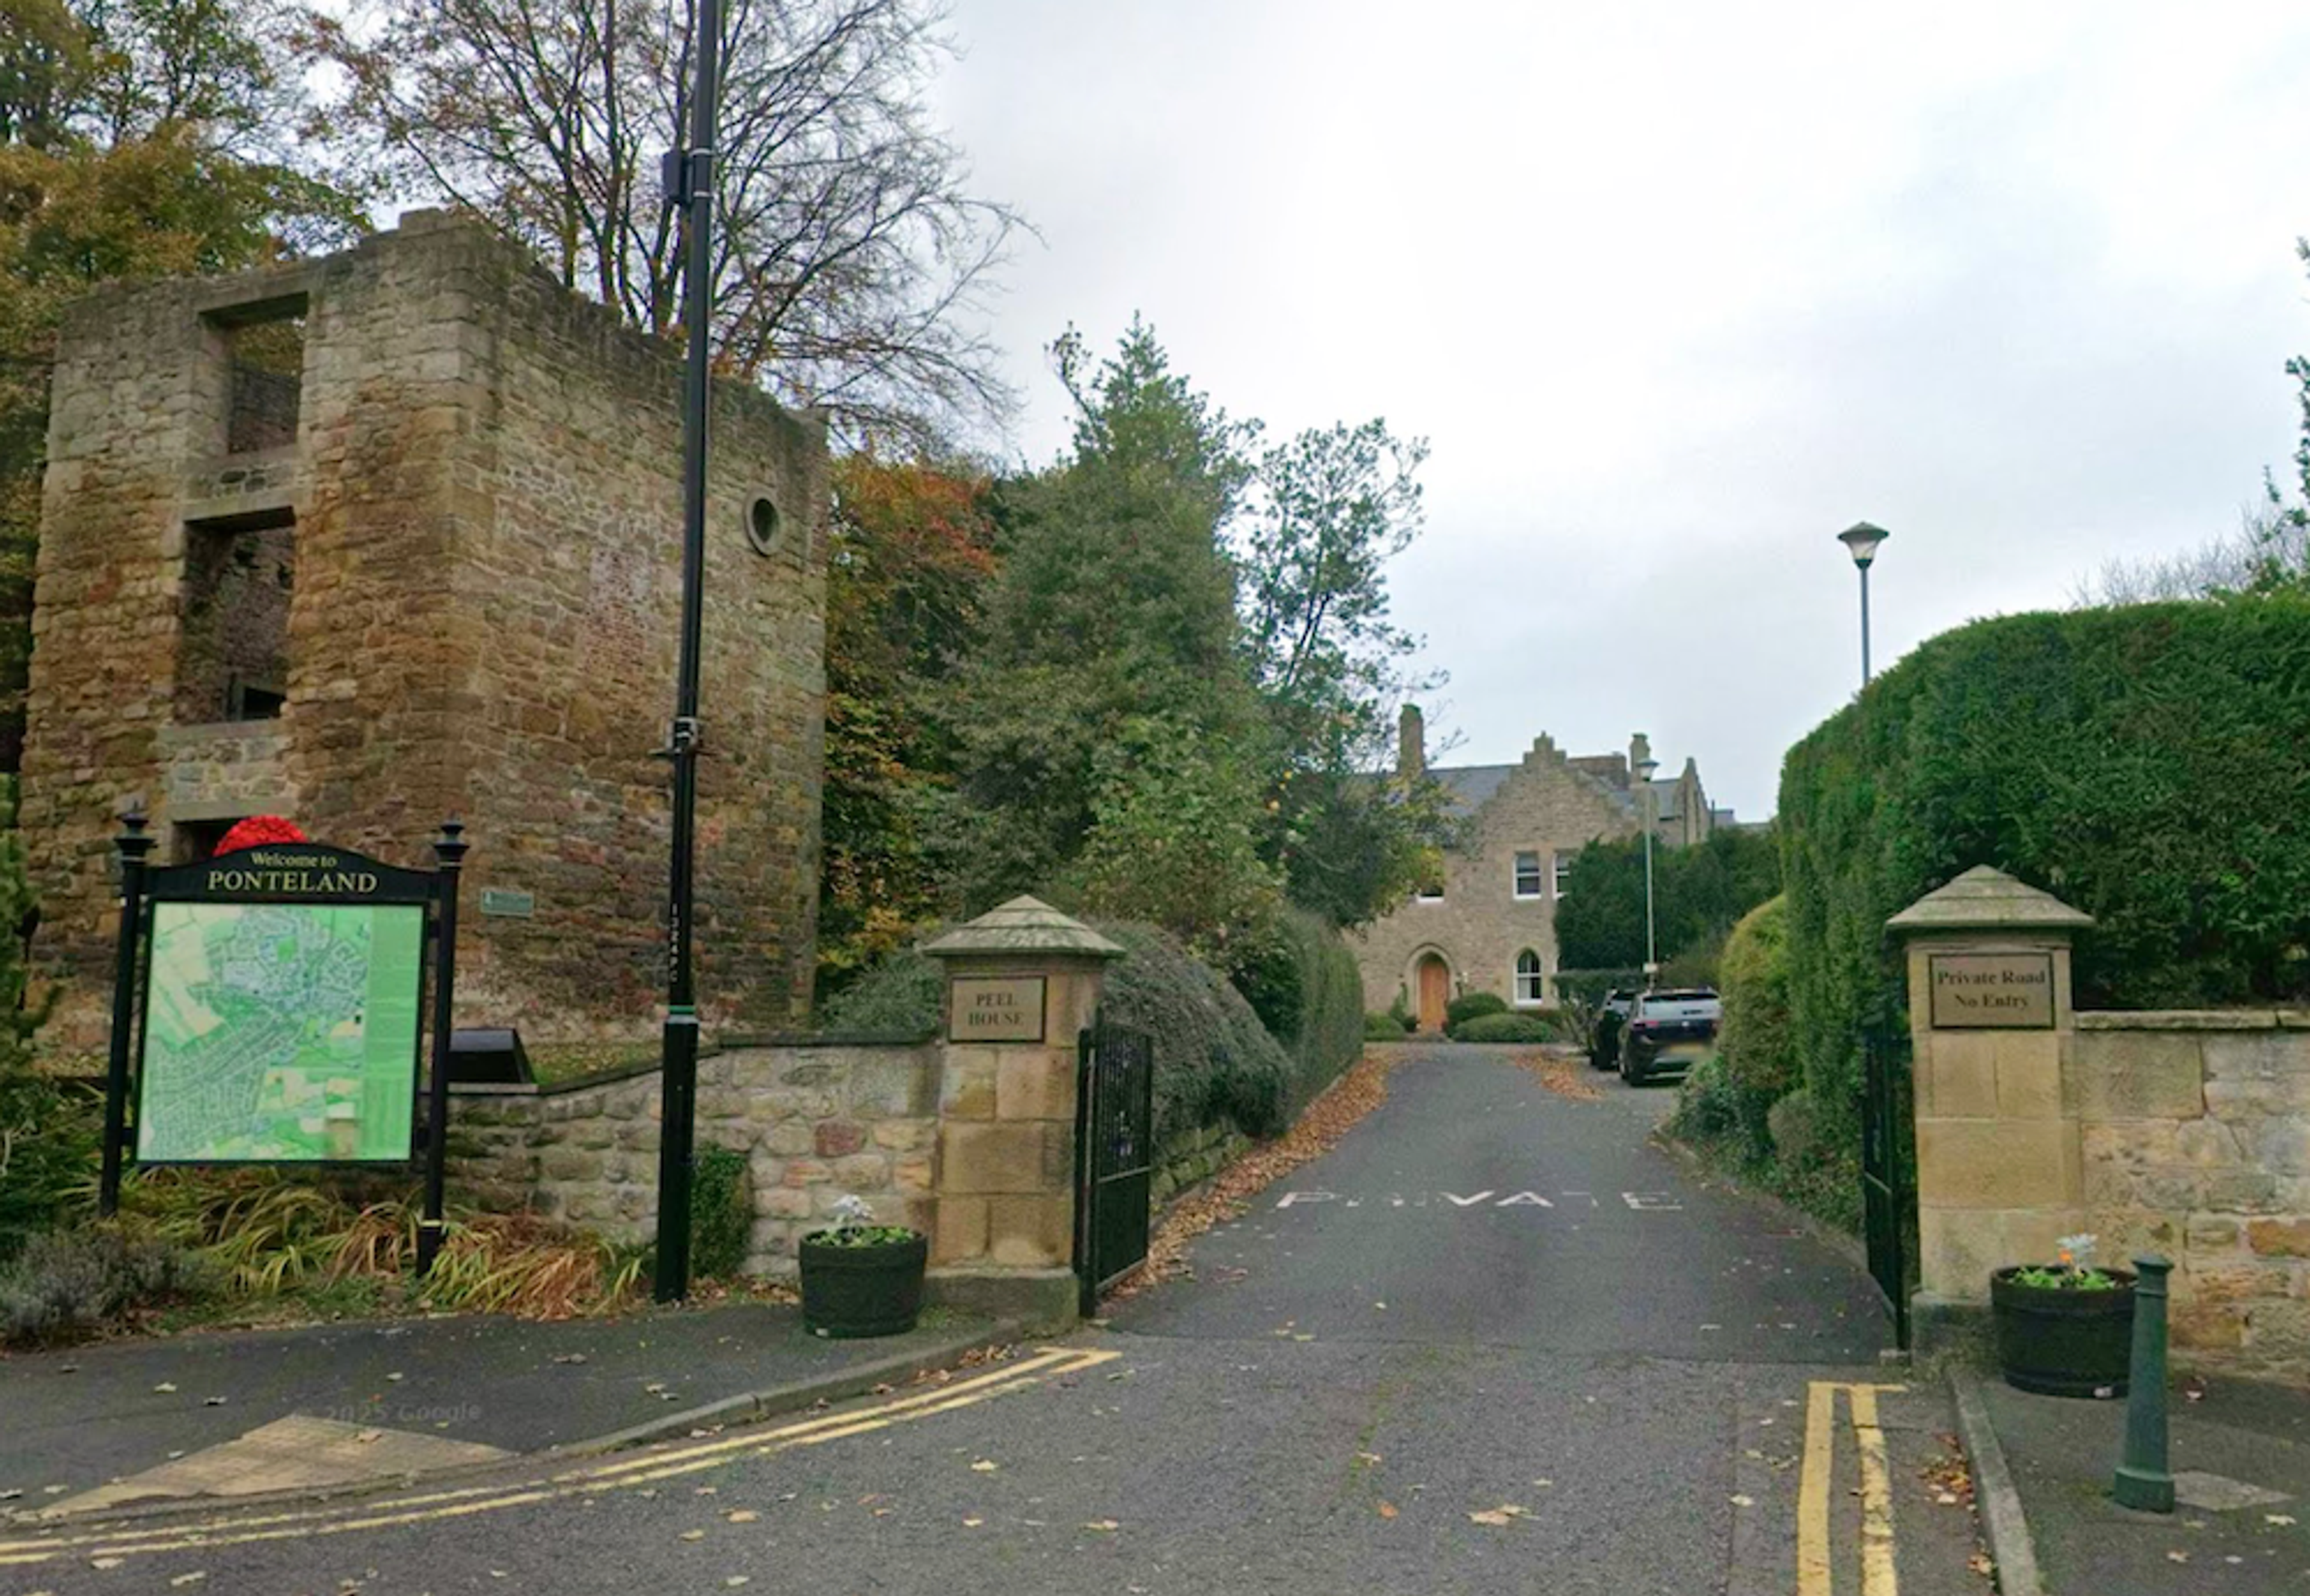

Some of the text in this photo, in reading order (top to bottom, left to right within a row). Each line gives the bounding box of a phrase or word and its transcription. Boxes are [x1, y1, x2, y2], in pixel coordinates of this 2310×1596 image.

[251, 852, 337, 868] Welcome to
[208, 870, 378, 893] PONTELAND
[1938, 969, 2045, 985] Private Road
[976, 993, 1019, 1007] PEEL
[1955, 994, 2028, 1011] No Entry
[969, 1012, 1024, 1026] HOUSE
